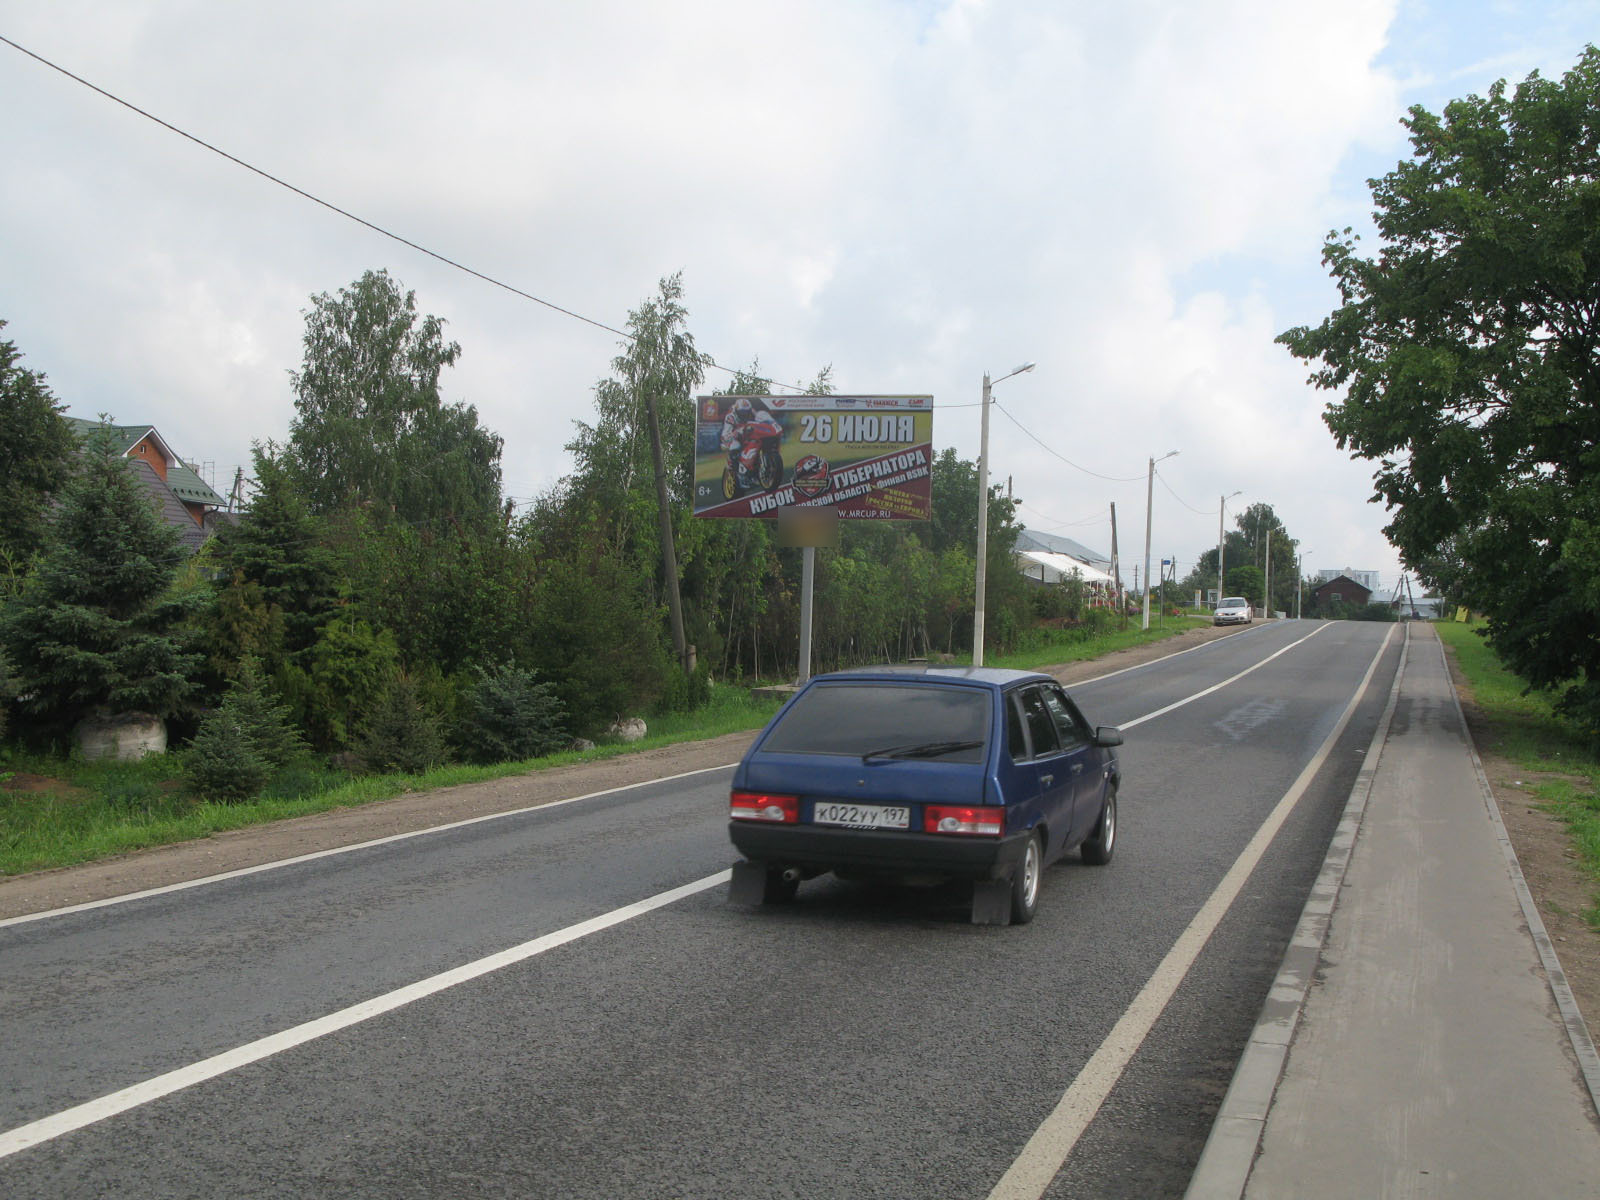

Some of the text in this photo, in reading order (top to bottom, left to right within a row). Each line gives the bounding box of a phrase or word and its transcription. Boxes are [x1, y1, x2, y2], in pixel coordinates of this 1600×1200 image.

[800, 415, 914, 442] 26 ИЮЛЯ
[749, 449, 927, 514] КУБОК ГУБЕРНАТОРА
[838, 510, 891, 518] W.MRCUP.RU
[882, 808, 905, 820] 197
